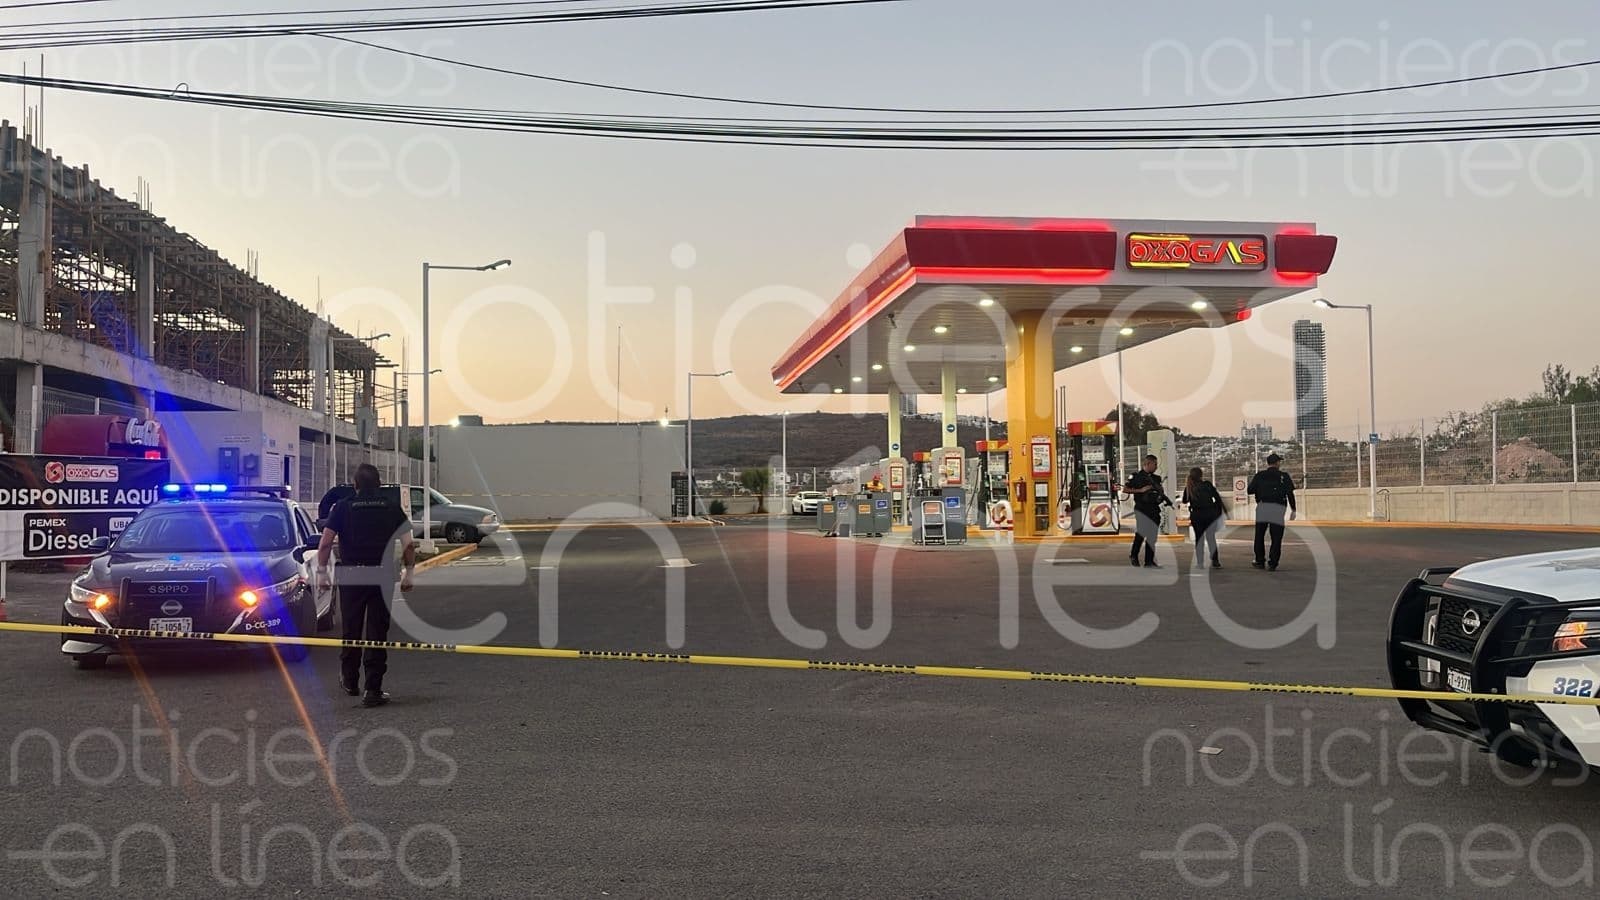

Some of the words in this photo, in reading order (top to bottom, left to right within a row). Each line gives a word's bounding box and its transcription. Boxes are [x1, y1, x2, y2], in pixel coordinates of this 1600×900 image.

[1129, 236, 1266, 266] OXXOGAS
[66, 466, 118, 480] OXXOGAS
[0, 488, 108, 505] DISPONIBLE
[114, 485, 159, 504] AQUÍ
[29, 518, 67, 527] PEMEX
[29, 527, 98, 551] Diesel
[1552, 677, 1593, 698] 322
